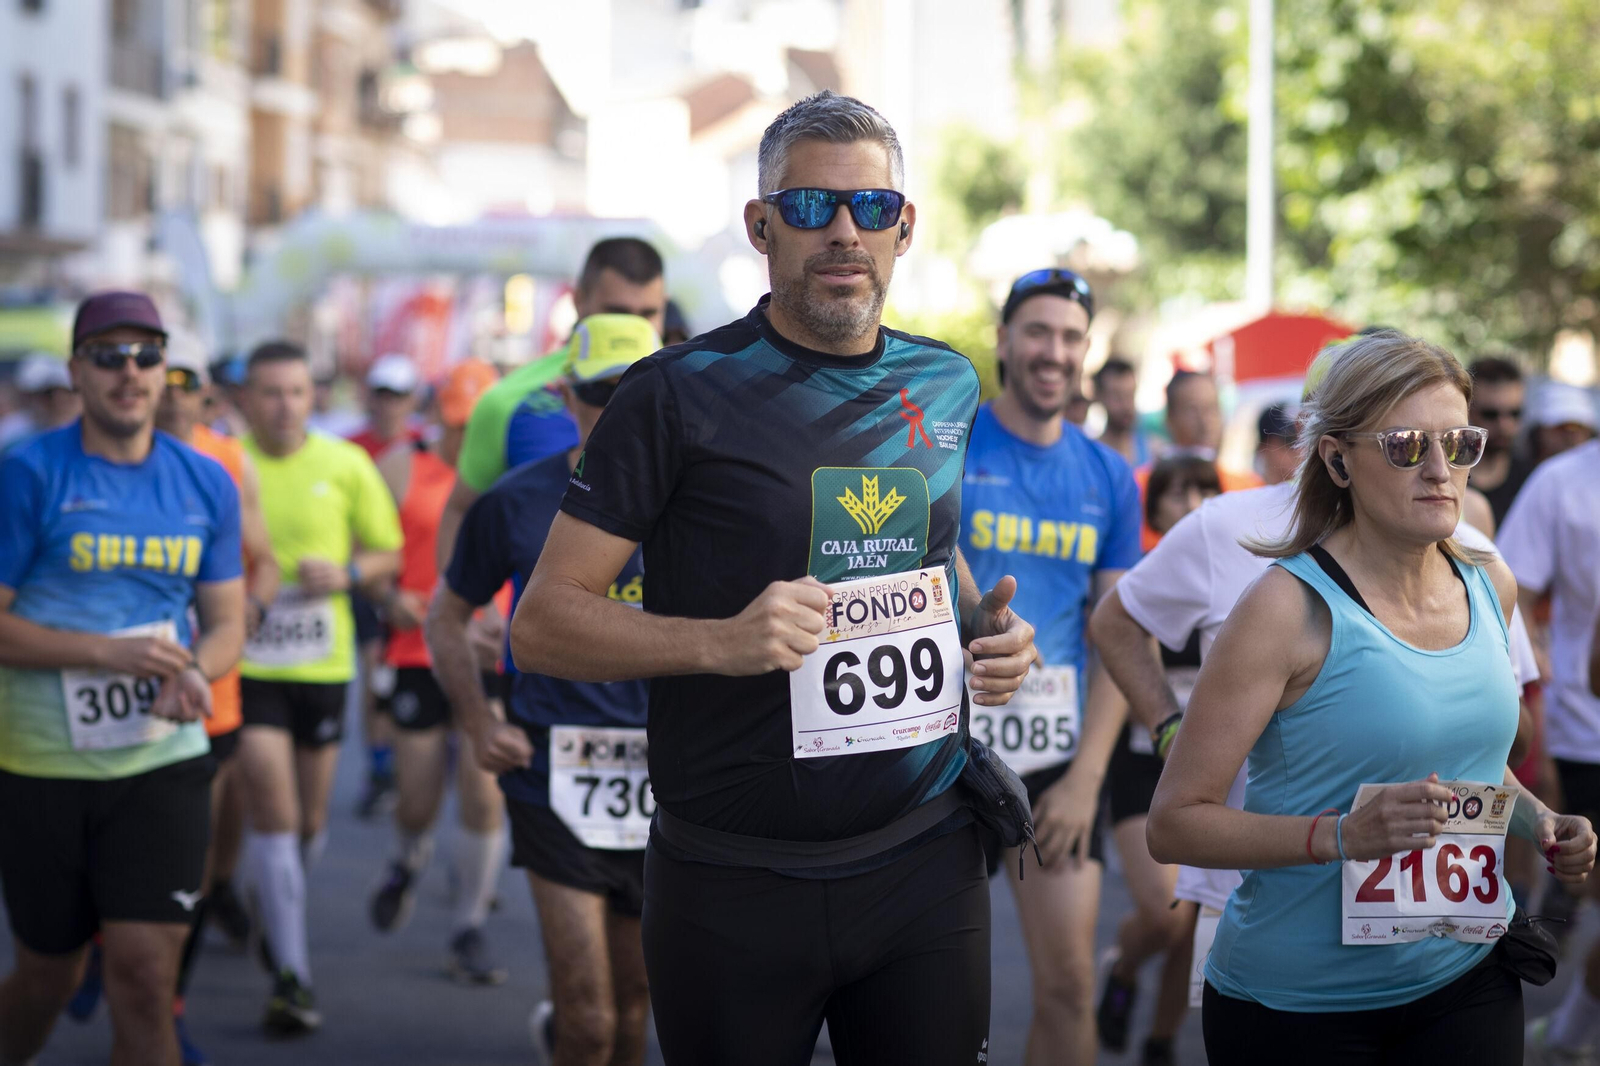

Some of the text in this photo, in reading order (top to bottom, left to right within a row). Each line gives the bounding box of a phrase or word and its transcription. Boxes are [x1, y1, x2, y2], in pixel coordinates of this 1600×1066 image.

[821, 538, 918, 555] CAJA RURAL
[847, 552, 888, 570] JAÉN
[832, 588, 866, 603] GRAN
[869, 580, 908, 597] PREMIO
[912, 595, 923, 606] 24
[832, 587, 927, 627] FONDO
[823, 637, 944, 715] 699
[892, 725, 921, 735] Cruzcampo
[974, 714, 1074, 752] 3085
[1466, 803, 1478, 813] 24
[1355, 843, 1499, 904] 2163
